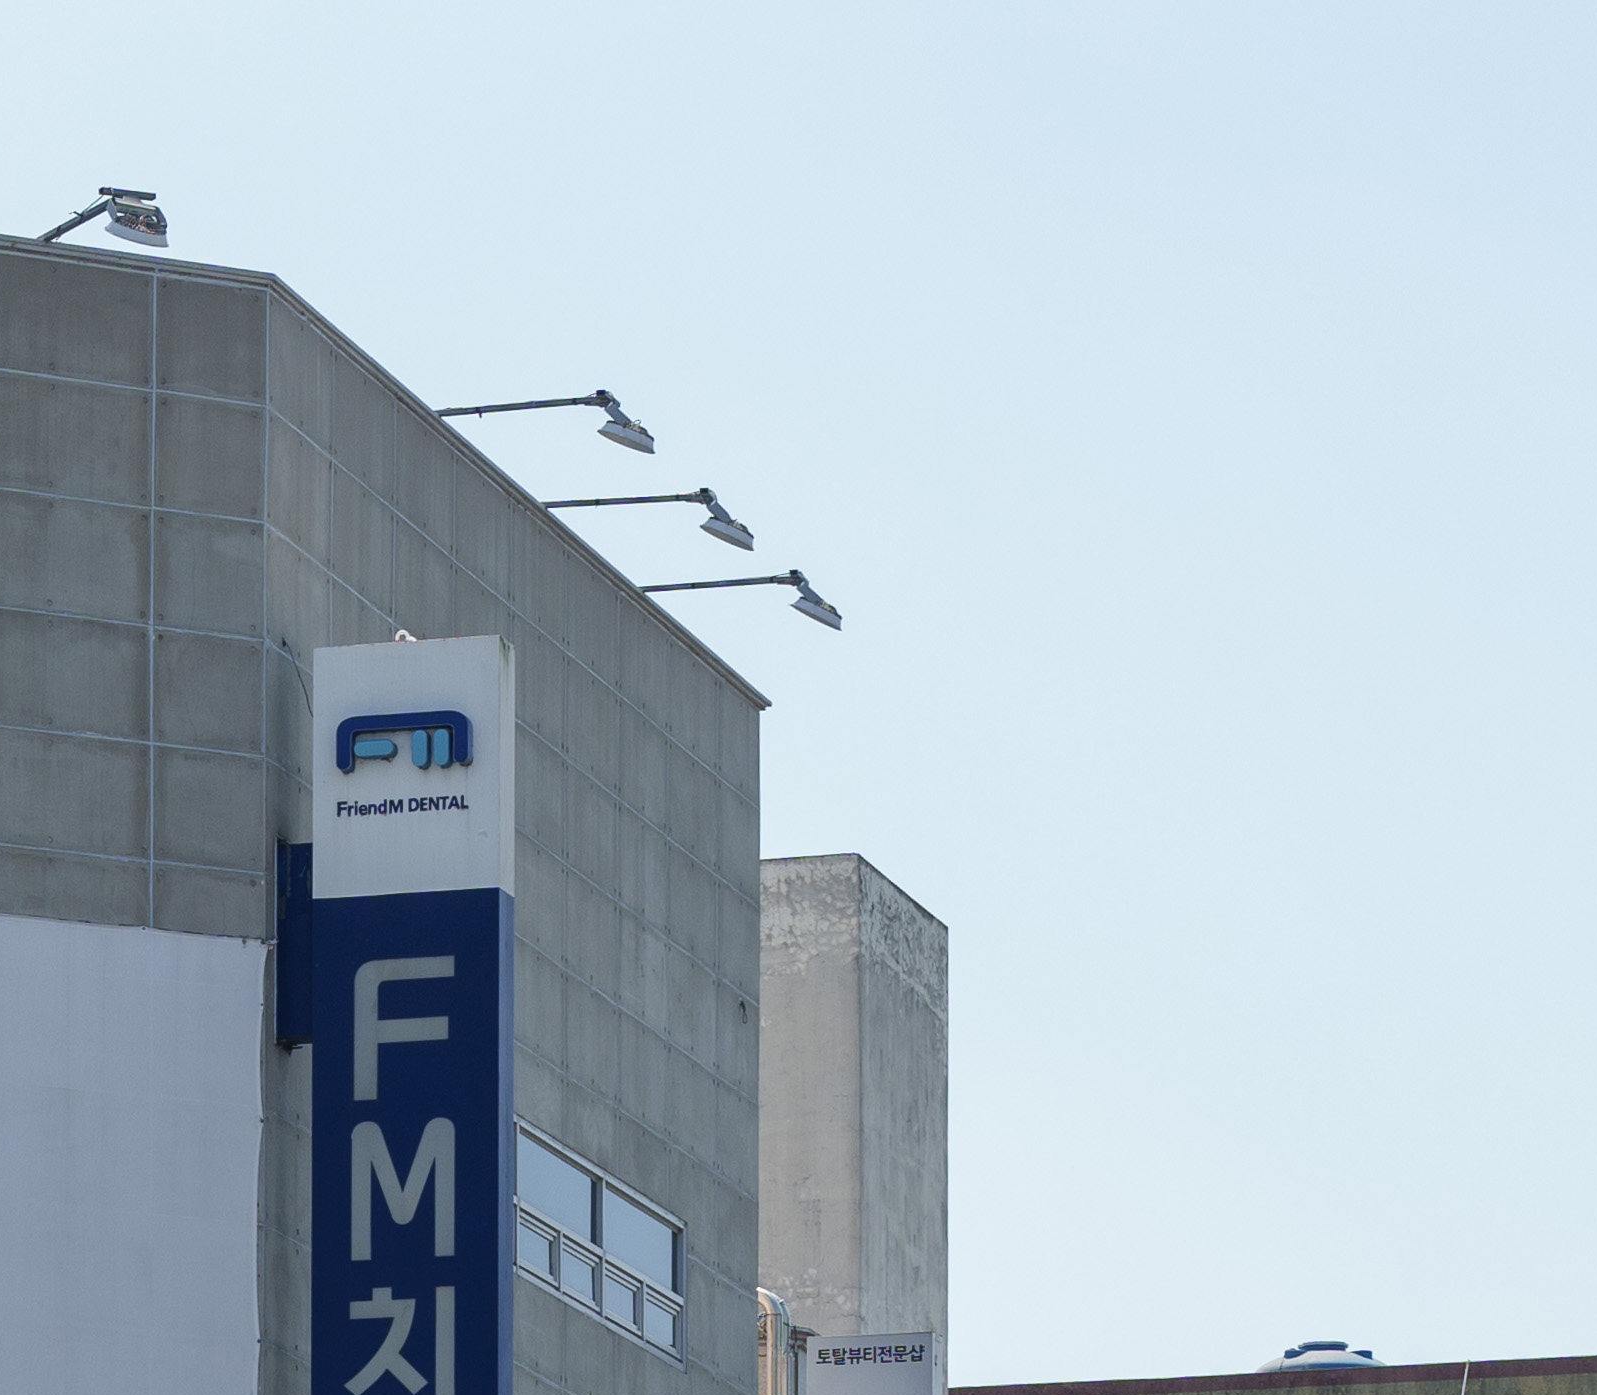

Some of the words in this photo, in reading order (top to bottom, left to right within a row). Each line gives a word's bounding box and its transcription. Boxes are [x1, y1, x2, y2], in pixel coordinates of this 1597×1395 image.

[337, 799, 403, 818] FriendM
[408, 795, 469, 812] DENTAL
[815, 1344, 925, 1366] 토탈뷰티전문샵
